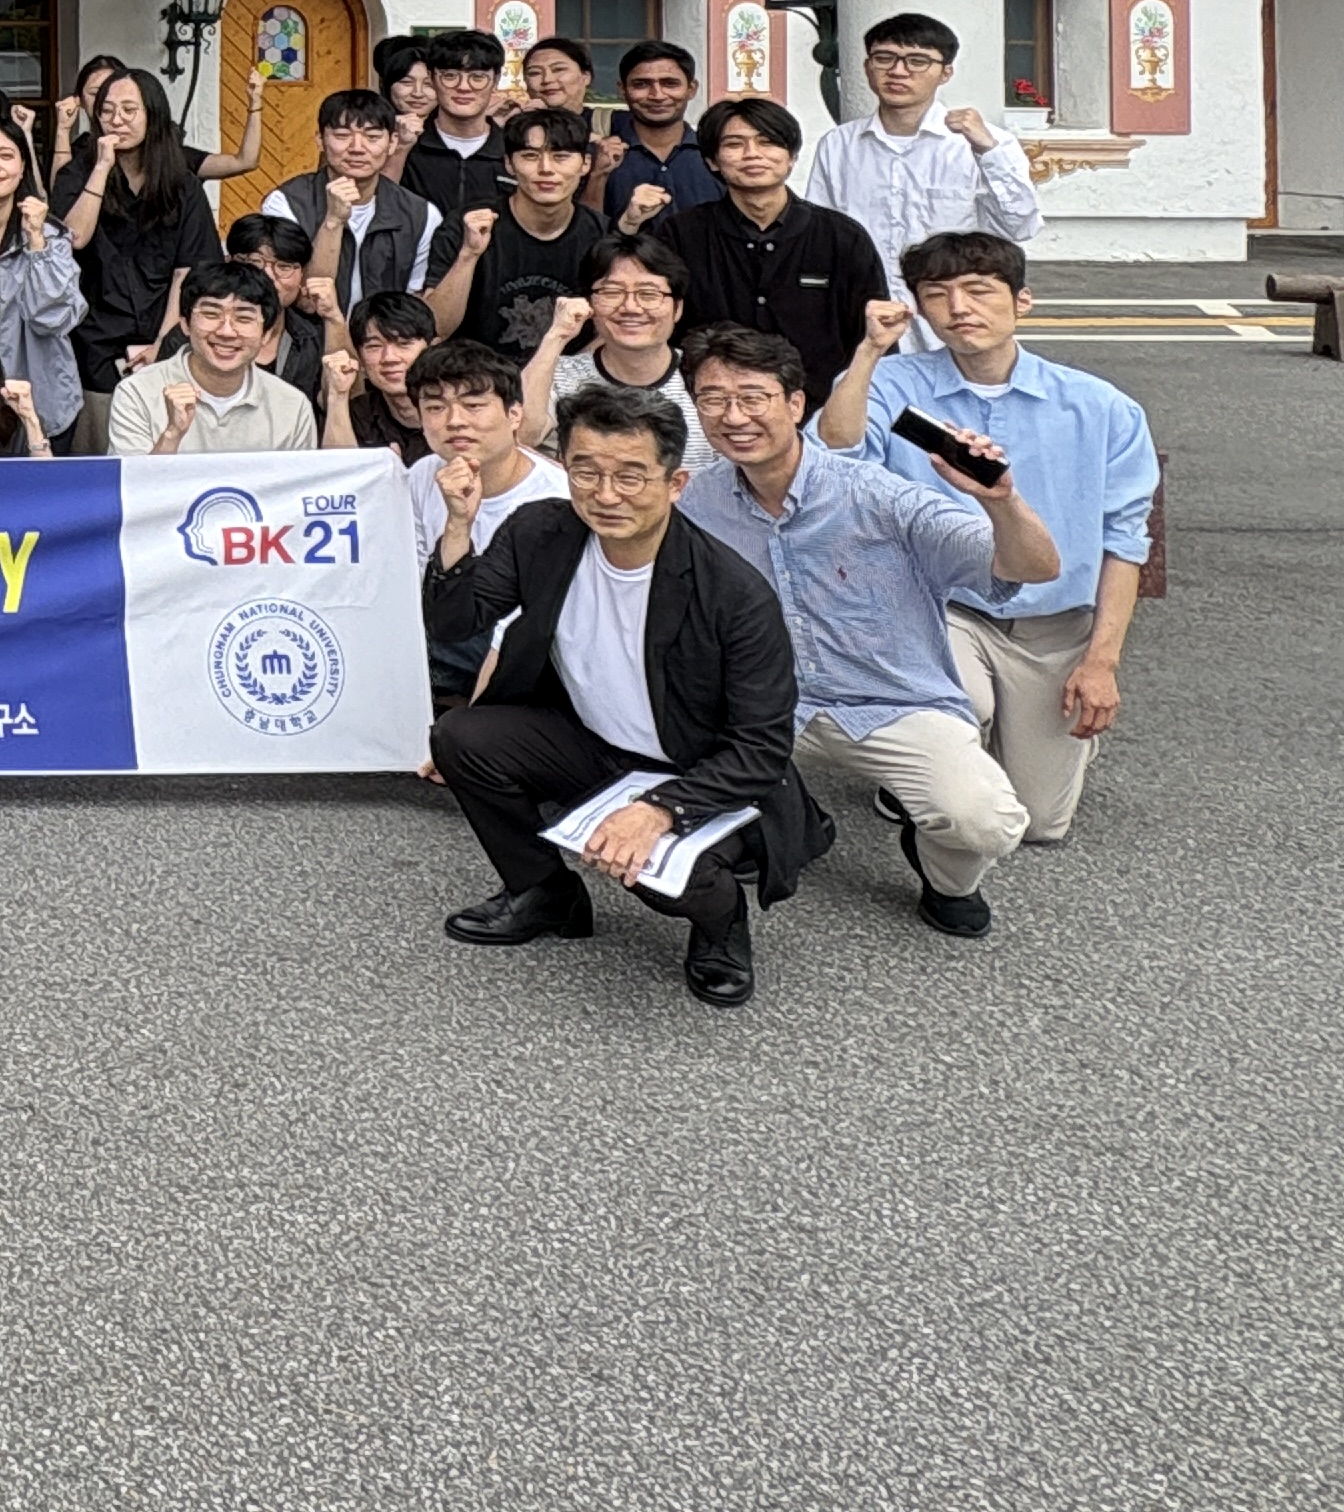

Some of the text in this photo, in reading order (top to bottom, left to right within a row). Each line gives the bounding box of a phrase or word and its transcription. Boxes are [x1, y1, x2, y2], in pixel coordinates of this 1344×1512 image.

[302, 494, 357, 514] FOUR
[213, 602, 340, 698] CHUNGNAM NATIONAL UNIVERSITY
